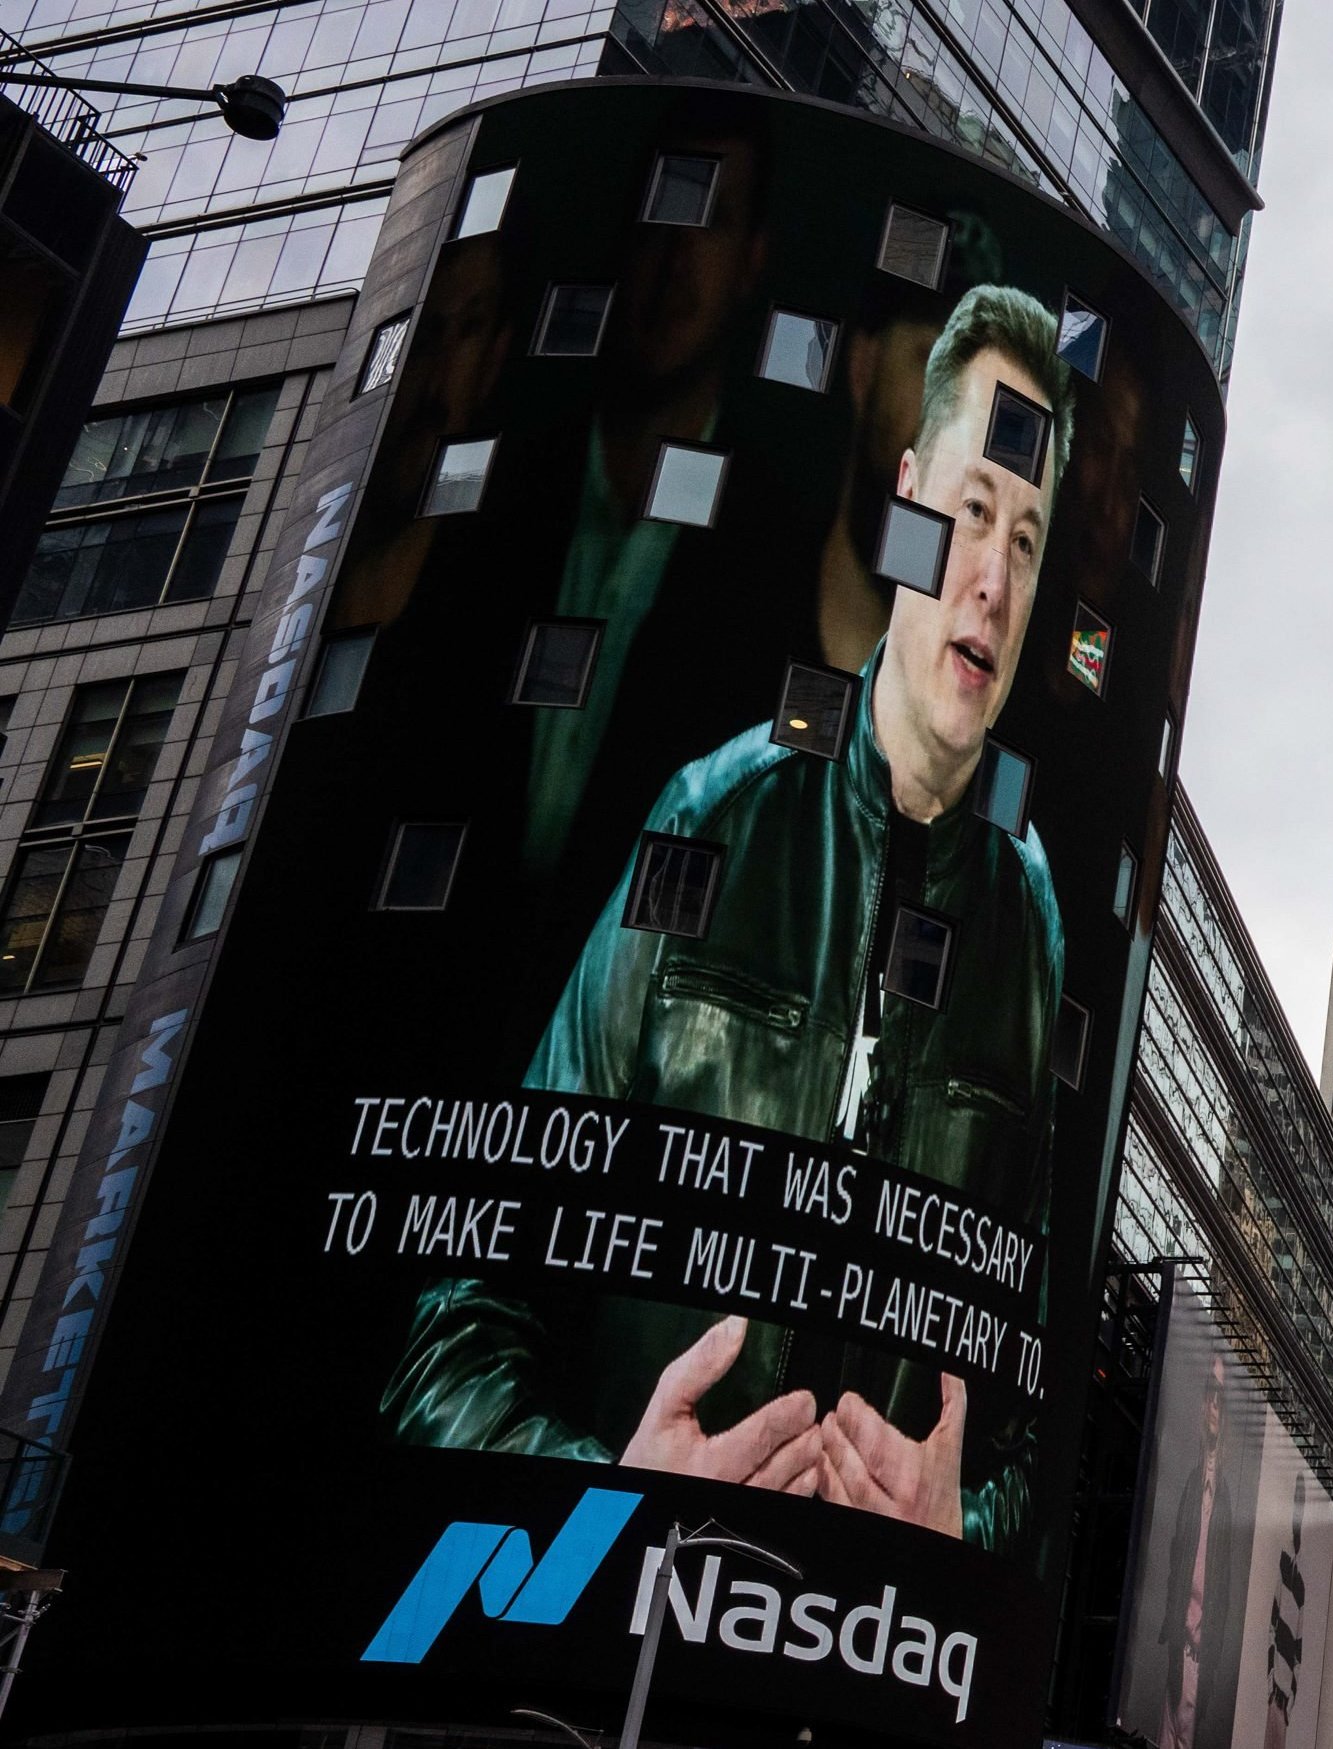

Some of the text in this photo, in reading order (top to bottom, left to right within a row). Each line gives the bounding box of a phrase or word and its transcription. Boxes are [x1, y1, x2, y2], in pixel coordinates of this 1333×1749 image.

[199, 482, 353, 855] NASDAQ
[324, 1190, 1045, 1399] TO MAKE LIFE MULTI-PLANETARY TO.
[351, 1096, 1033, 1293] TECHNOLOGY THAT WAS NECESSARY
[629, 1546, 978, 1723] Nasdaq
